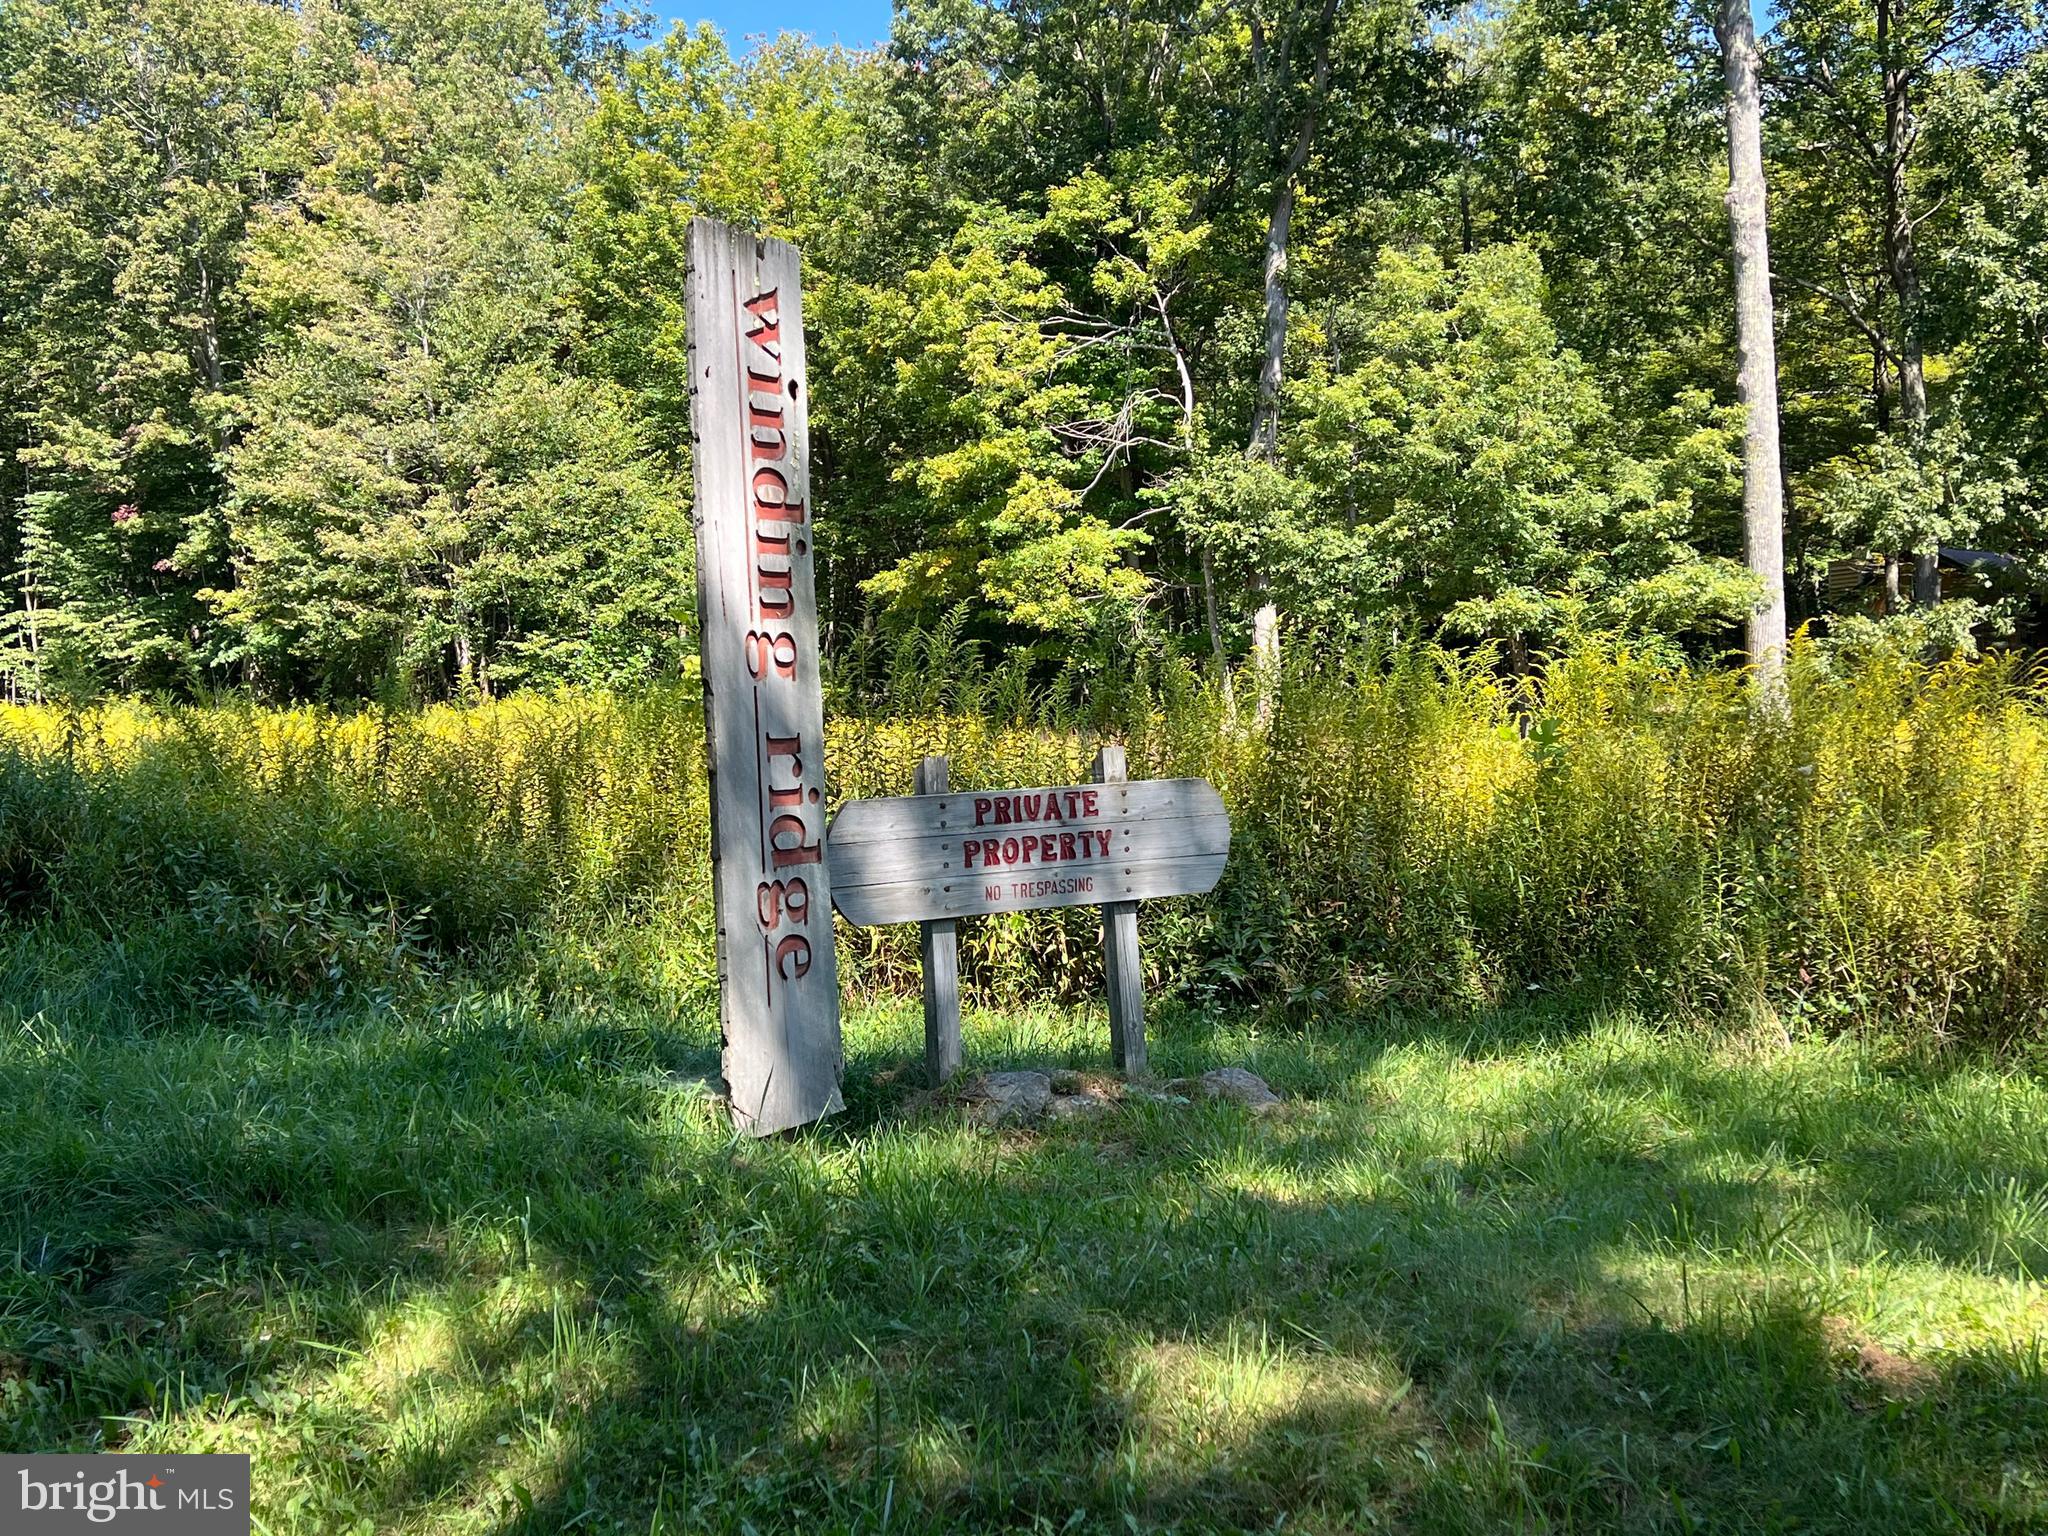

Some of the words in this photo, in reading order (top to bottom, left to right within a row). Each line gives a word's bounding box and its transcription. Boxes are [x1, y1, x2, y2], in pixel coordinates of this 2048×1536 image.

[744, 287, 805, 681] winding
[973, 790, 1100, 827] PRIVATE
[757, 731, 823, 980] ridge
[963, 829, 1113, 868] PROPERTY
[985, 885, 1002, 901] NO
[1011, 877, 1093, 898] TRESPASSING
